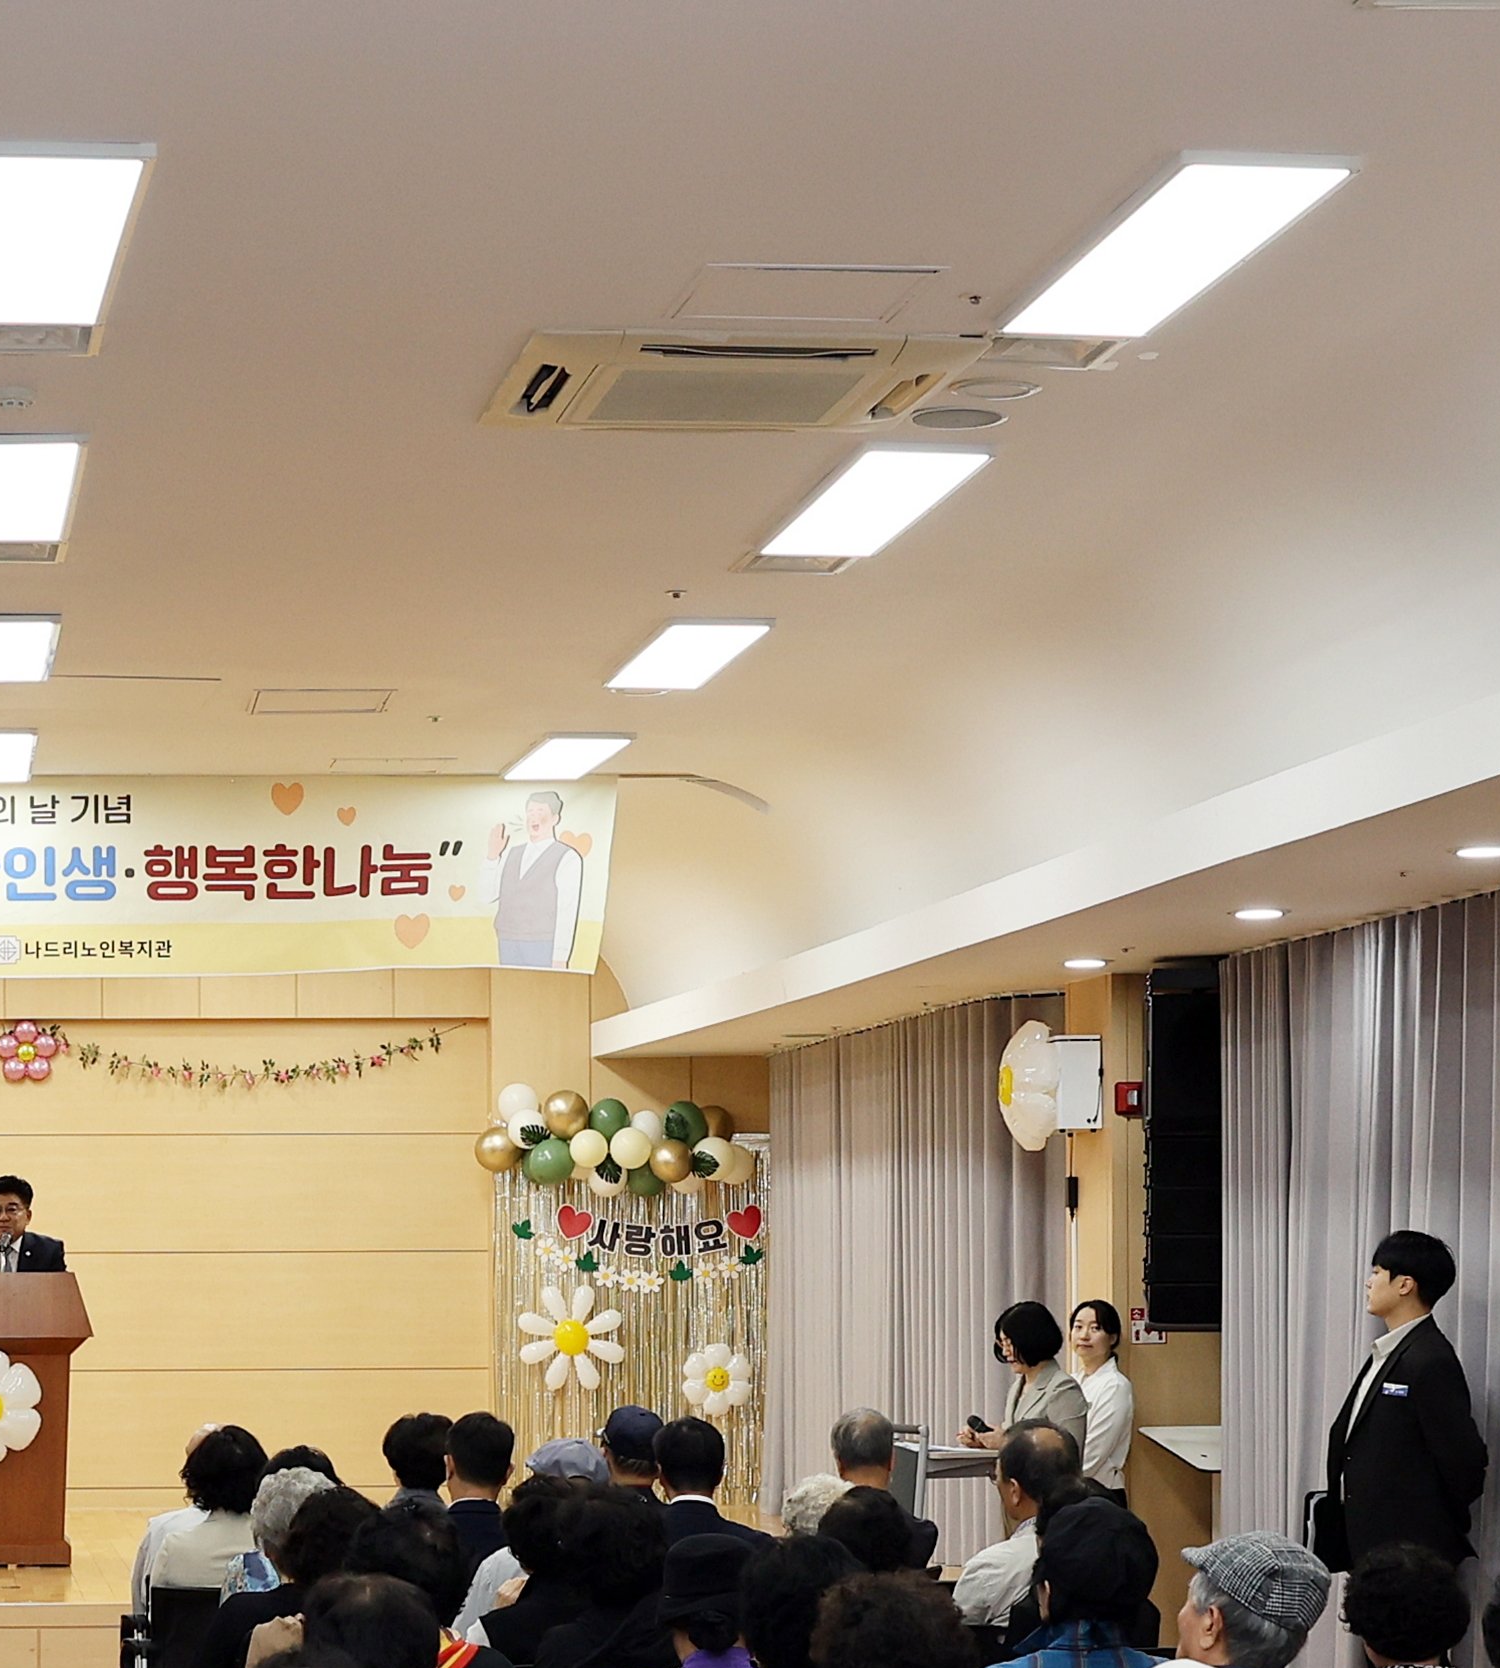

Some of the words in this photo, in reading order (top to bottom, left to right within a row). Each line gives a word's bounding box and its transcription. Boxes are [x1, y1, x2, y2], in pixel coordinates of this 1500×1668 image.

[30, 795, 60, 824] 날
[71, 794, 131, 824] 기념
[25, 940, 172, 959] 나드리노인복지관
[588, 1219, 728, 1257] 사랑해요
